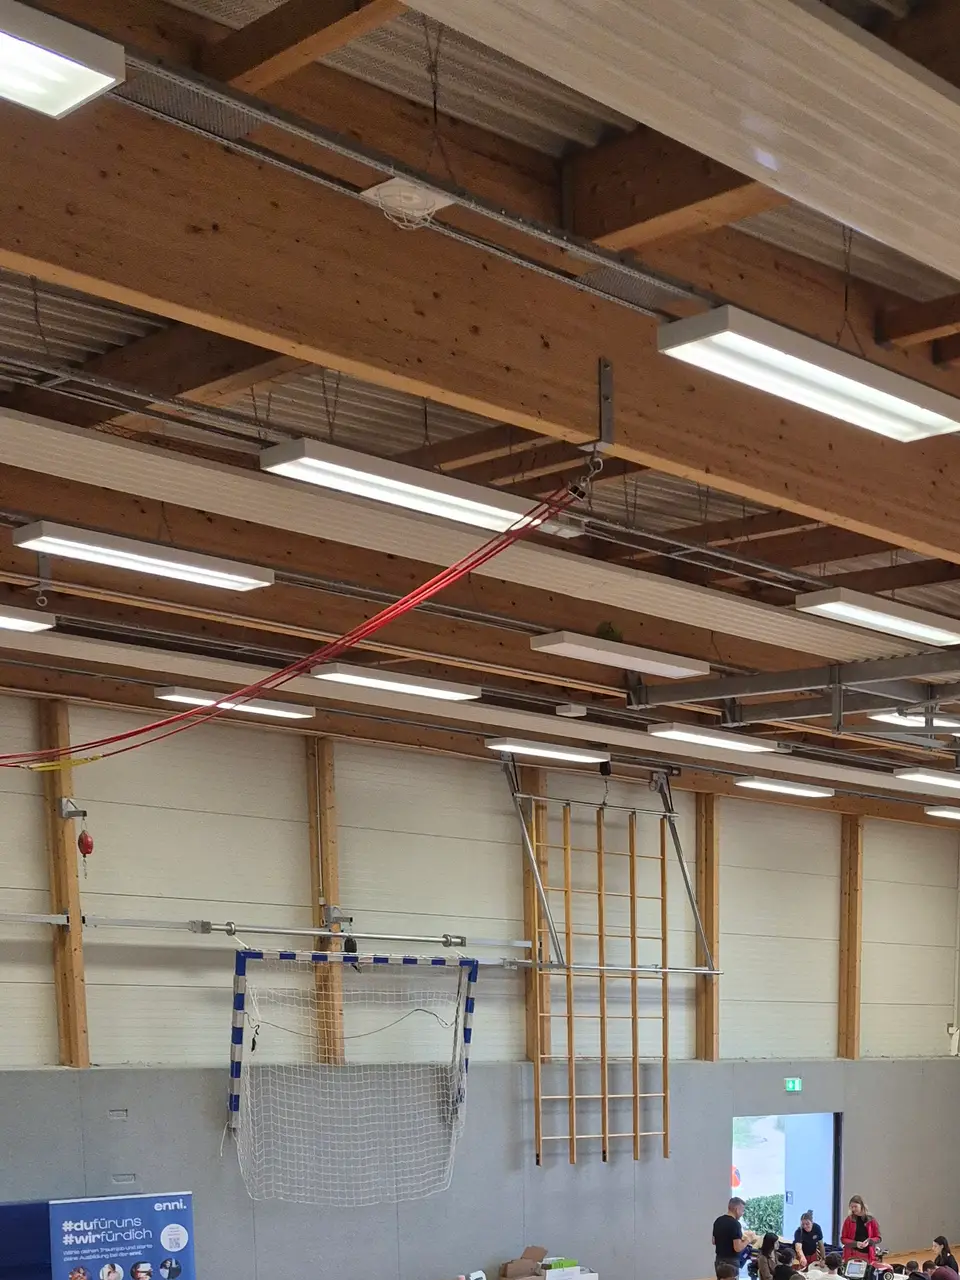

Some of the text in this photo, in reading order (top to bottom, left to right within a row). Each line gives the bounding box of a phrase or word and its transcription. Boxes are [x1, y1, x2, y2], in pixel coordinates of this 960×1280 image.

[154, 1198, 187, 1212] enni.
[62, 1217, 142, 1232] #dufüruns
[62, 1228, 153, 1245] #wirfürdich
